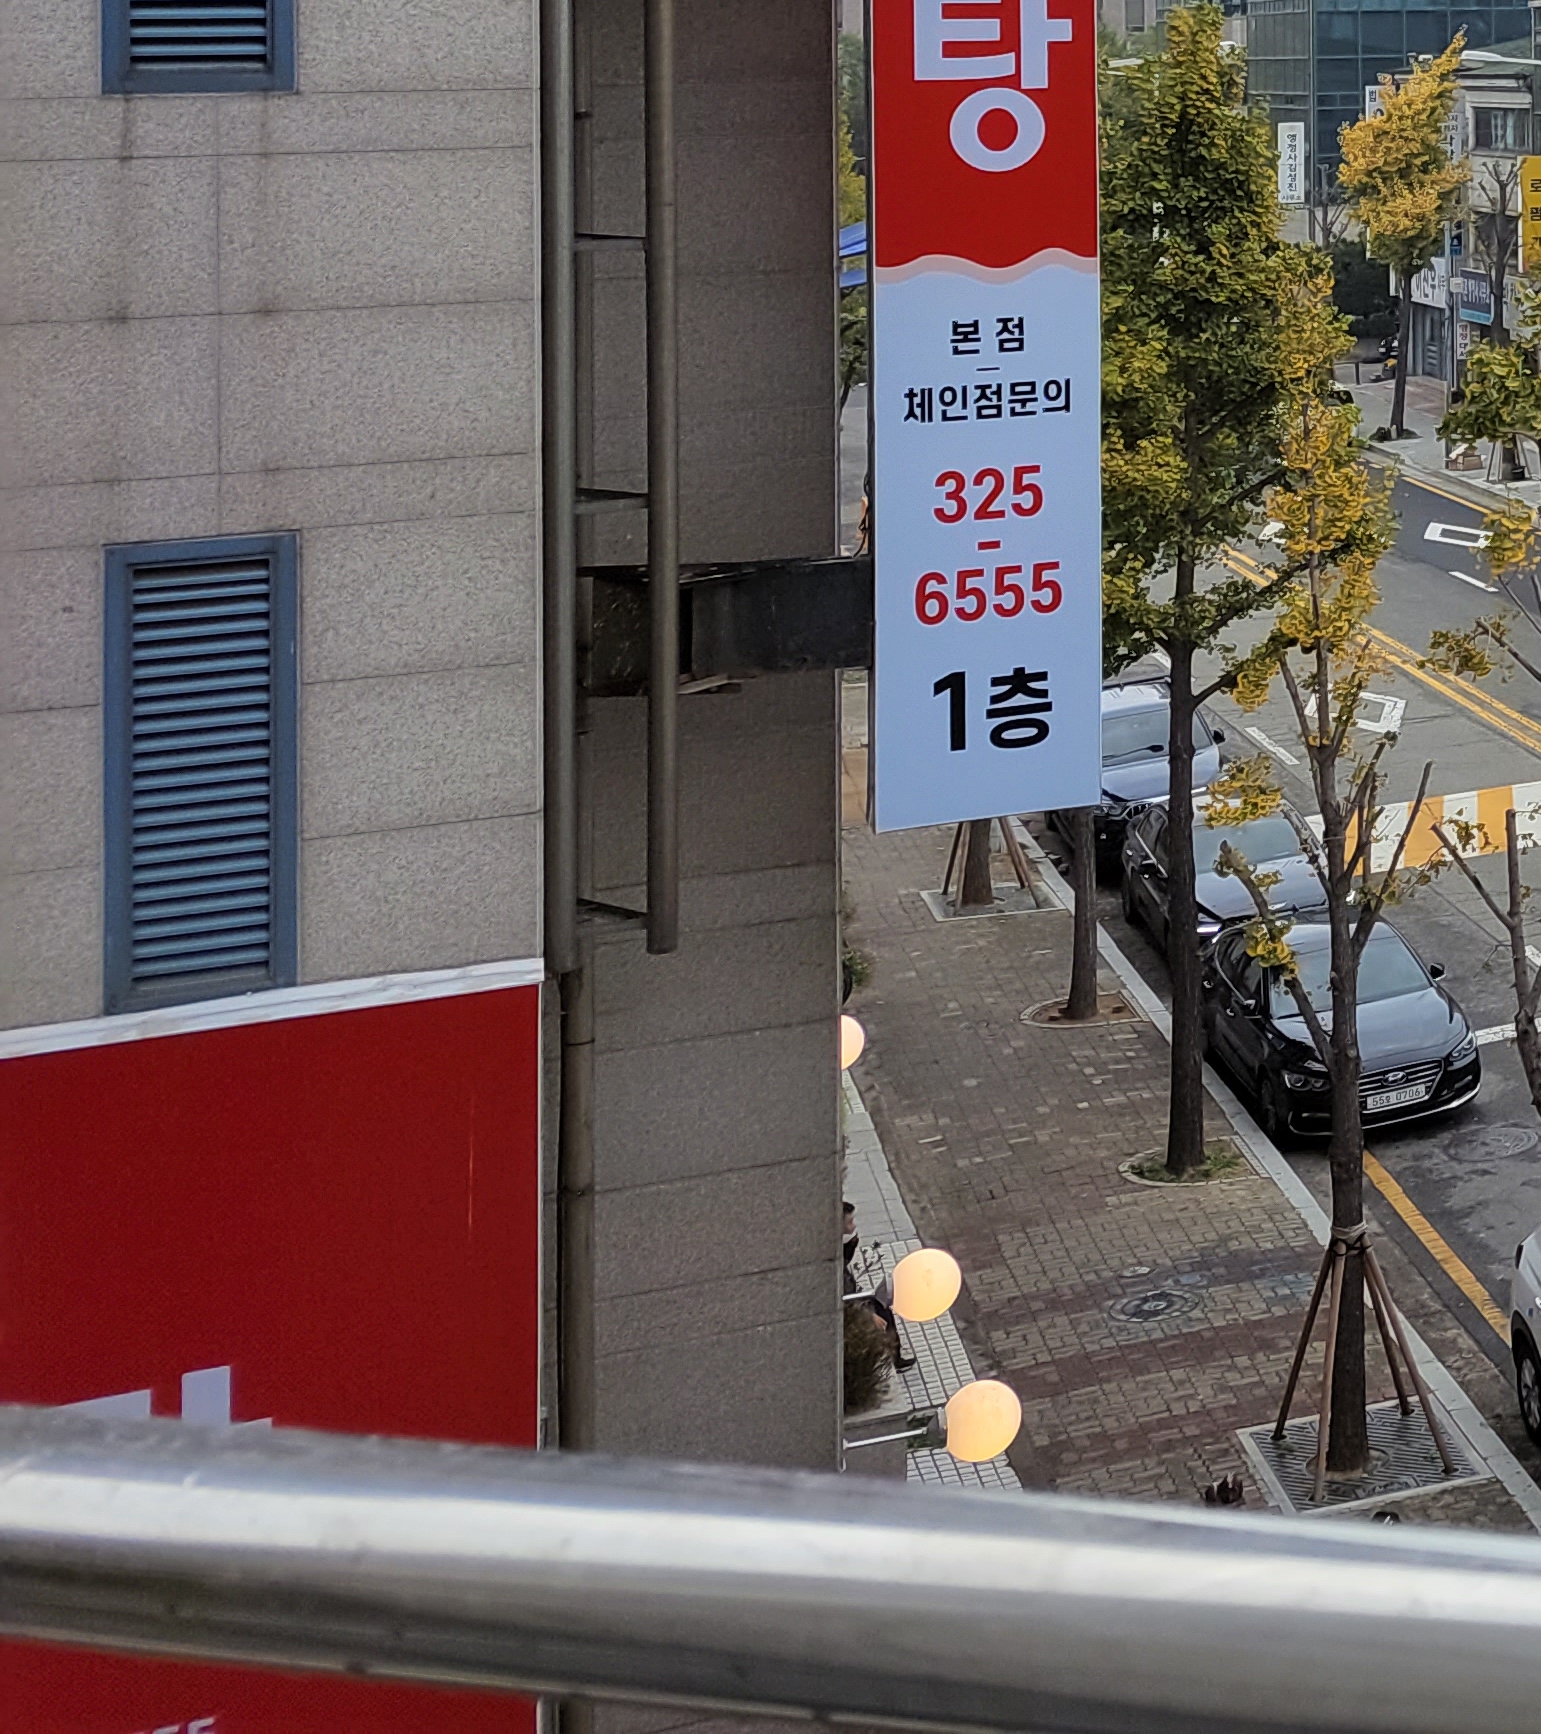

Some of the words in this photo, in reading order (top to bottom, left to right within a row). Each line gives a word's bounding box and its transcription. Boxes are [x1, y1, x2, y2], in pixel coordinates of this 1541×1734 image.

[902, 377, 1072, 425] 체인점문의
[932, 464, 1044, 526] 325
[913, 560, 1064, 627] 6555
[931, 665, 1055, 753] 1층
